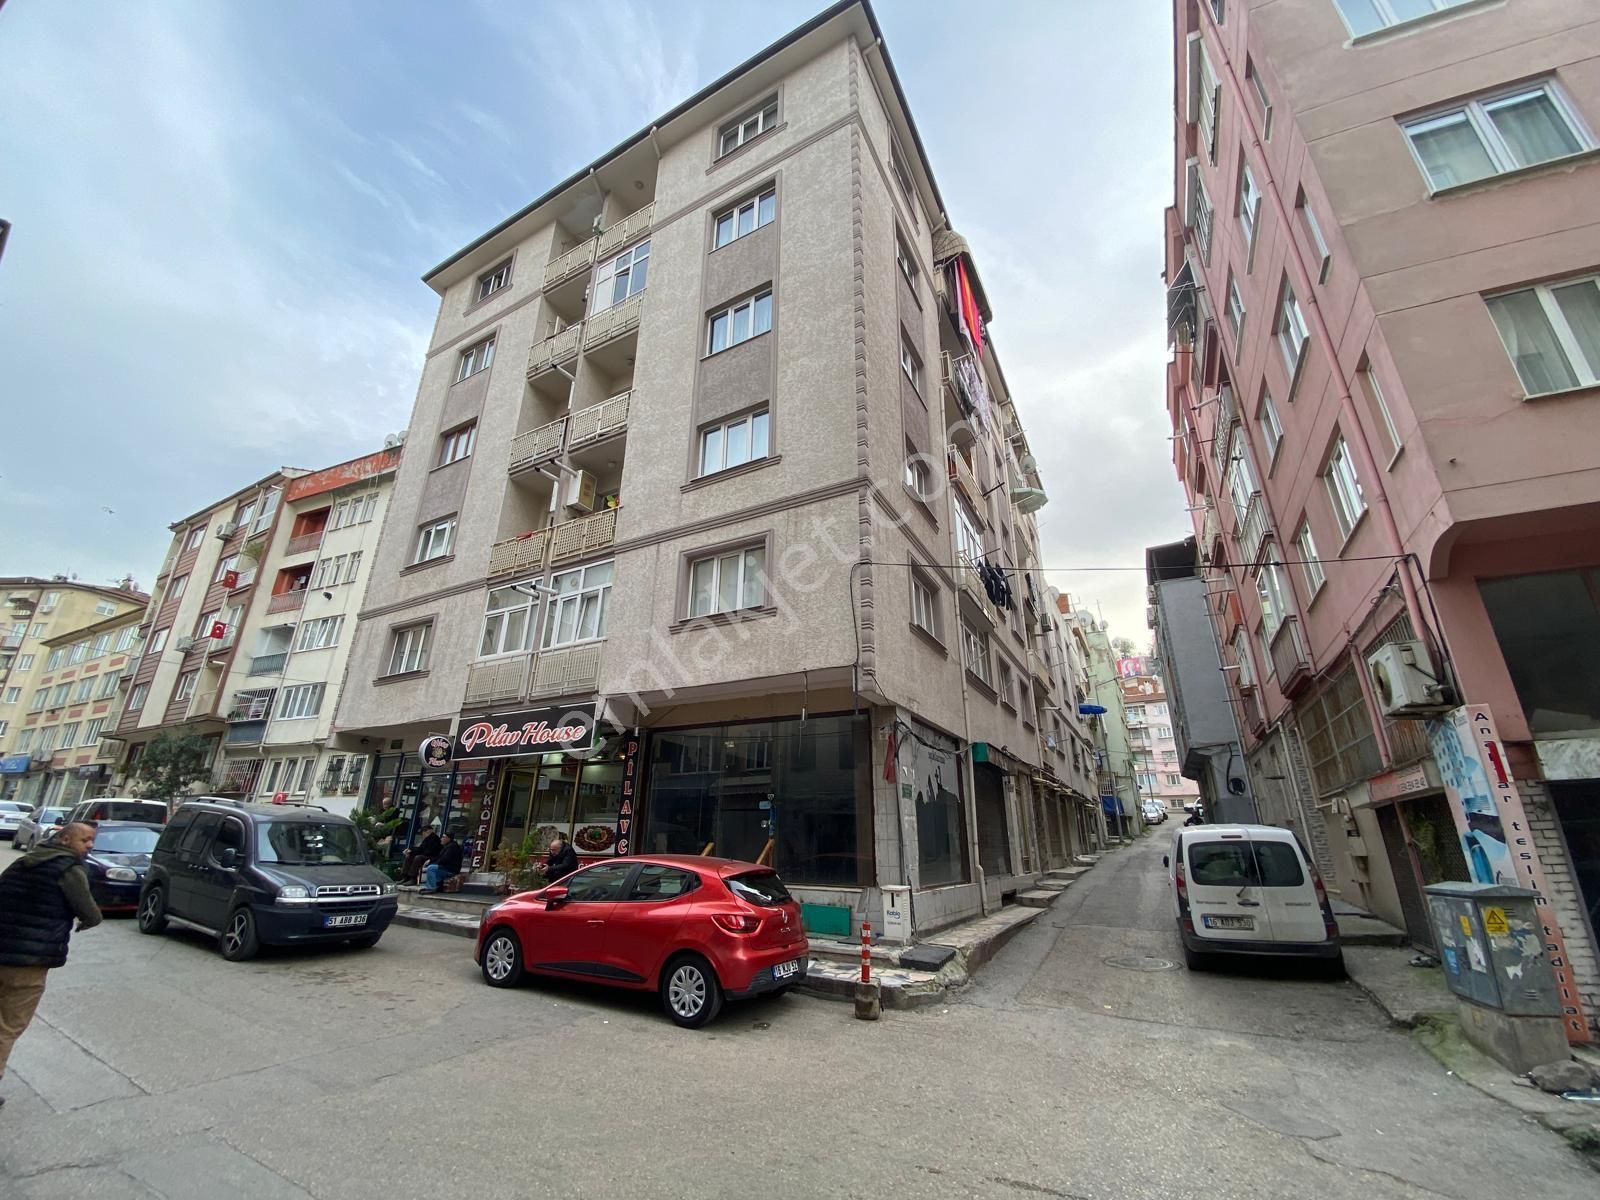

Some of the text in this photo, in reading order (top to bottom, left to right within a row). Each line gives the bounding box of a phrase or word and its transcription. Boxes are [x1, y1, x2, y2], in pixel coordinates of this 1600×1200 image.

[461, 721, 587, 752] Pilav House
[1512, 821, 1548, 906] teslim
[329, 915, 367, 925] 51 ABB 836
[1209, 918, 1218, 926] 16
[1543, 926, 1581, 1031] tadilat
